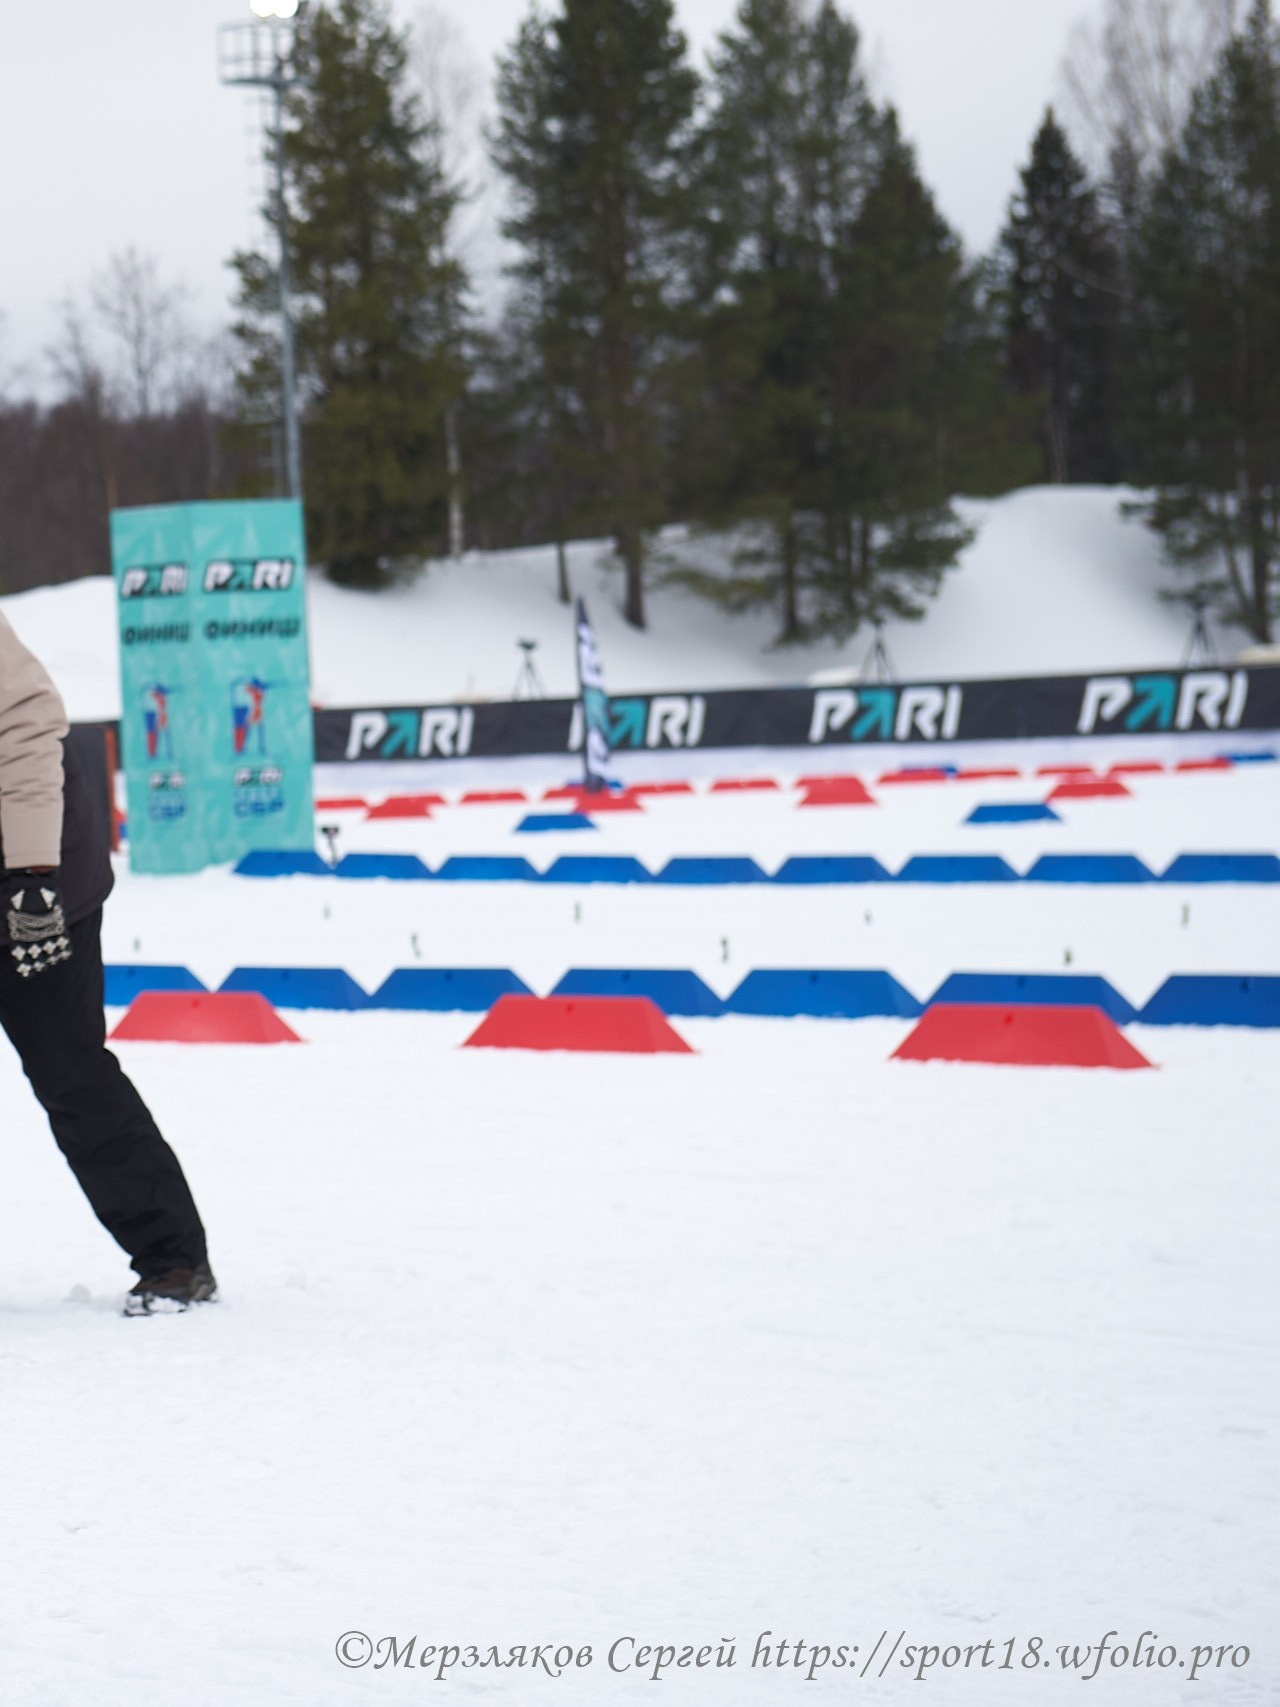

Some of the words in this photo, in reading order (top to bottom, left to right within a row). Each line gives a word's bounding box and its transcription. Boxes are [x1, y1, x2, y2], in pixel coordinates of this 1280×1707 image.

[204, 559, 293, 592] PARI
[809, 685, 962, 743] PARI
[1077, 671, 1249, 734] PARI
[345, 706, 474, 760] PARI
